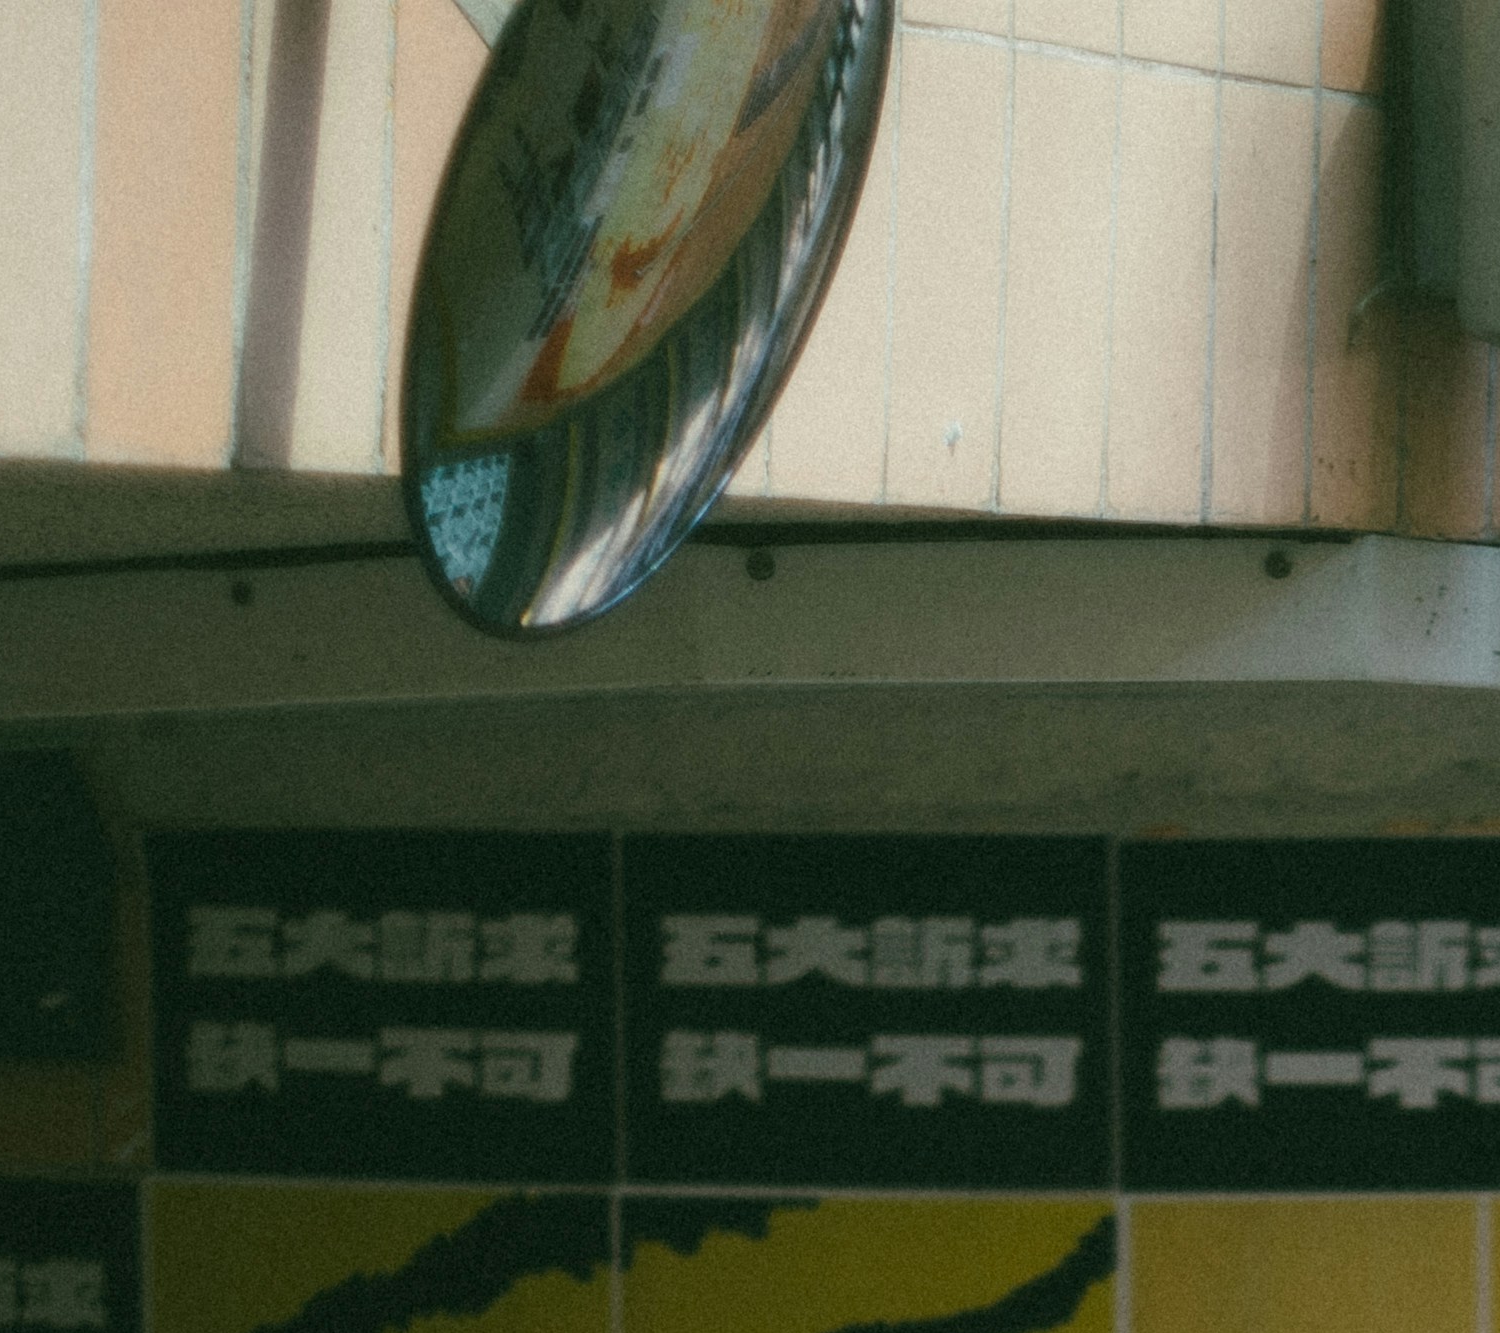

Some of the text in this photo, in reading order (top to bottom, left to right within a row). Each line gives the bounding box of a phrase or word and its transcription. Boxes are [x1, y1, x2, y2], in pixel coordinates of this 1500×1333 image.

[191, 908, 579, 985] 五大訴求
[664, 916, 1083, 989] 五大訴求
[190, 1024, 579, 1103] 缺一不可
[663, 1032, 1082, 1108] 缺一不可
